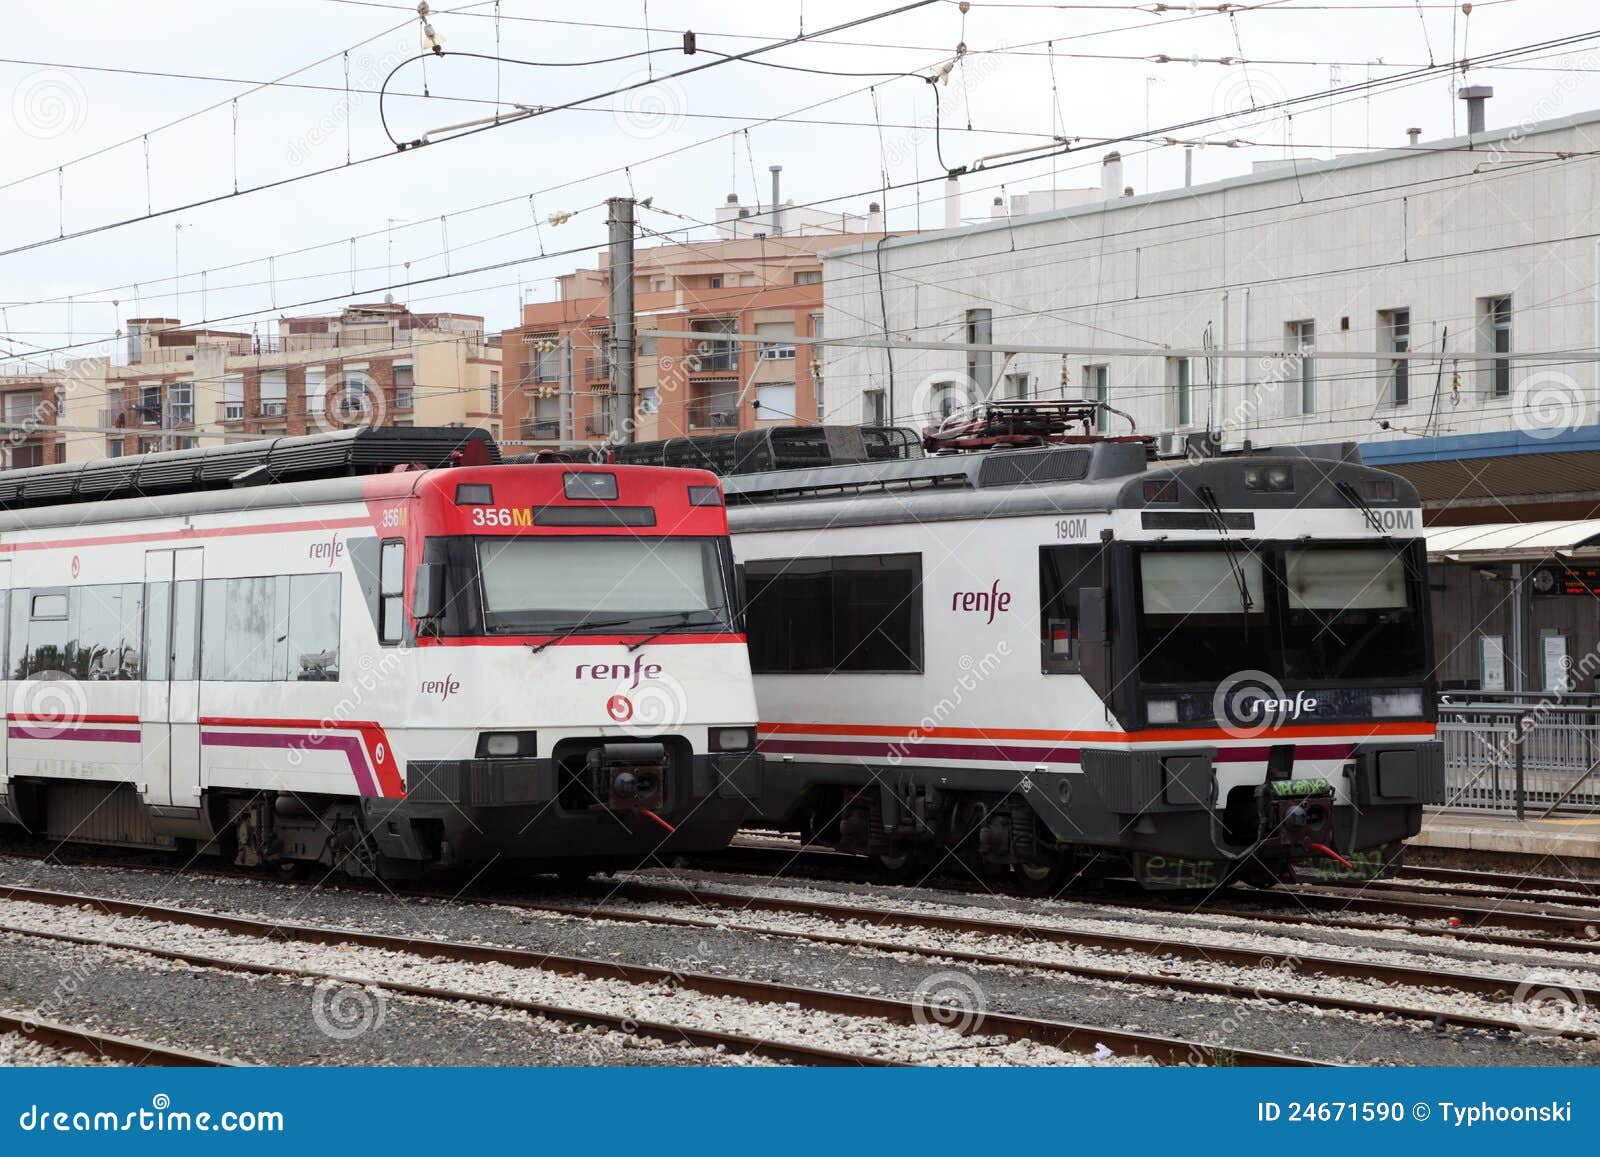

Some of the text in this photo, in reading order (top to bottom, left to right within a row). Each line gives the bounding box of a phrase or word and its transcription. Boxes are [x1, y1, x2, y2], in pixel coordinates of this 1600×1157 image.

[382, 507, 408, 527] 356M
[472, 508, 532, 527] 356M
[1055, 518, 1088, 539] 190M
[1361, 510, 1414, 530] 190M
[309, 532, 344, 568] renfe
[952, 578, 1012, 625] renfe
[575, 653, 662, 690] renfe
[421, 673, 460, 702] renfe
[1252, 690, 1318, 720] renfe
